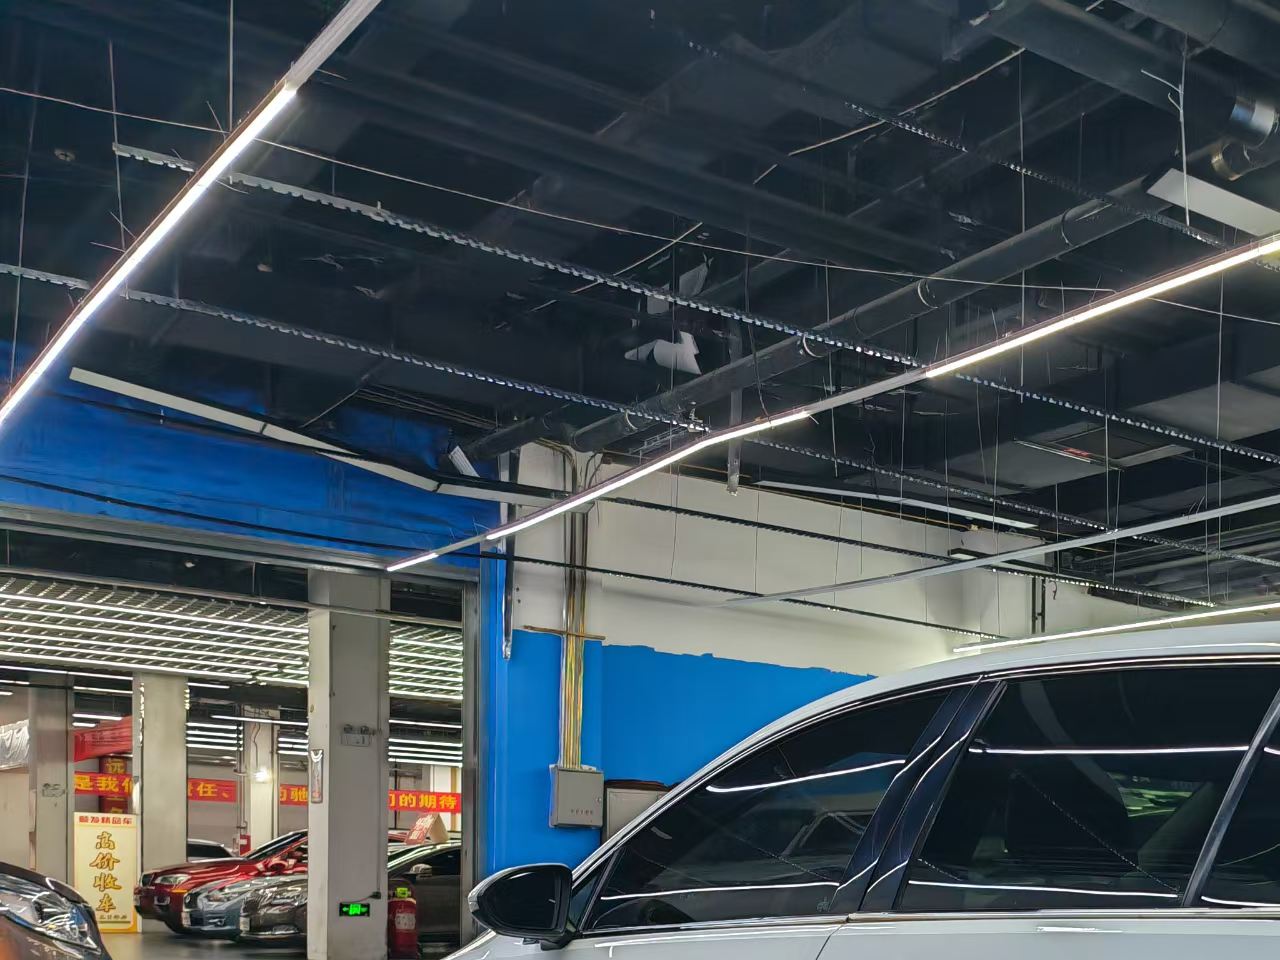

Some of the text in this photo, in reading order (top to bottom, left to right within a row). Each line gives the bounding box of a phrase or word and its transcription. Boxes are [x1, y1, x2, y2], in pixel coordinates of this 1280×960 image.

[188, 782, 229, 798] 任、
[89, 831, 122, 913] 高价收车
